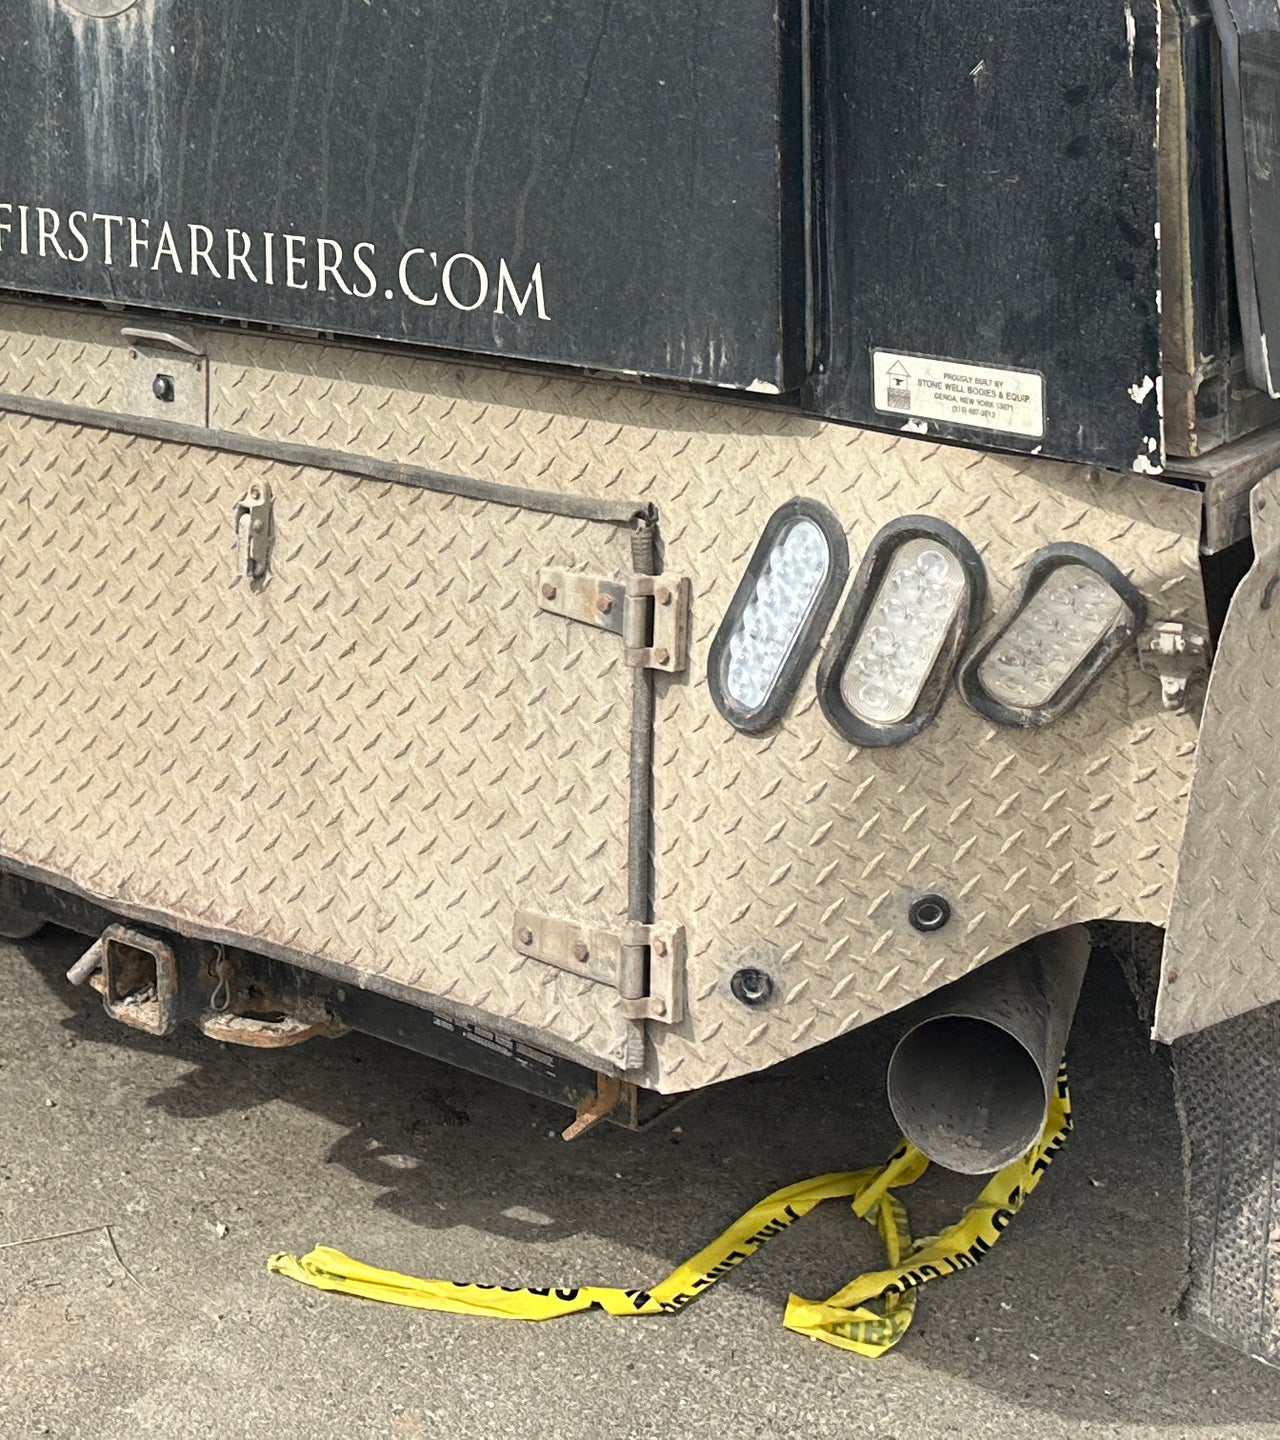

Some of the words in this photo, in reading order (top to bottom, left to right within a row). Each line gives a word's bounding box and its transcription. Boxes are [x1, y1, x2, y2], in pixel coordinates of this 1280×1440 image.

[917, 378, 943, 391] STONE
[944, 382, 966, 394] WELL
[967, 386, 997, 399] BODIES
